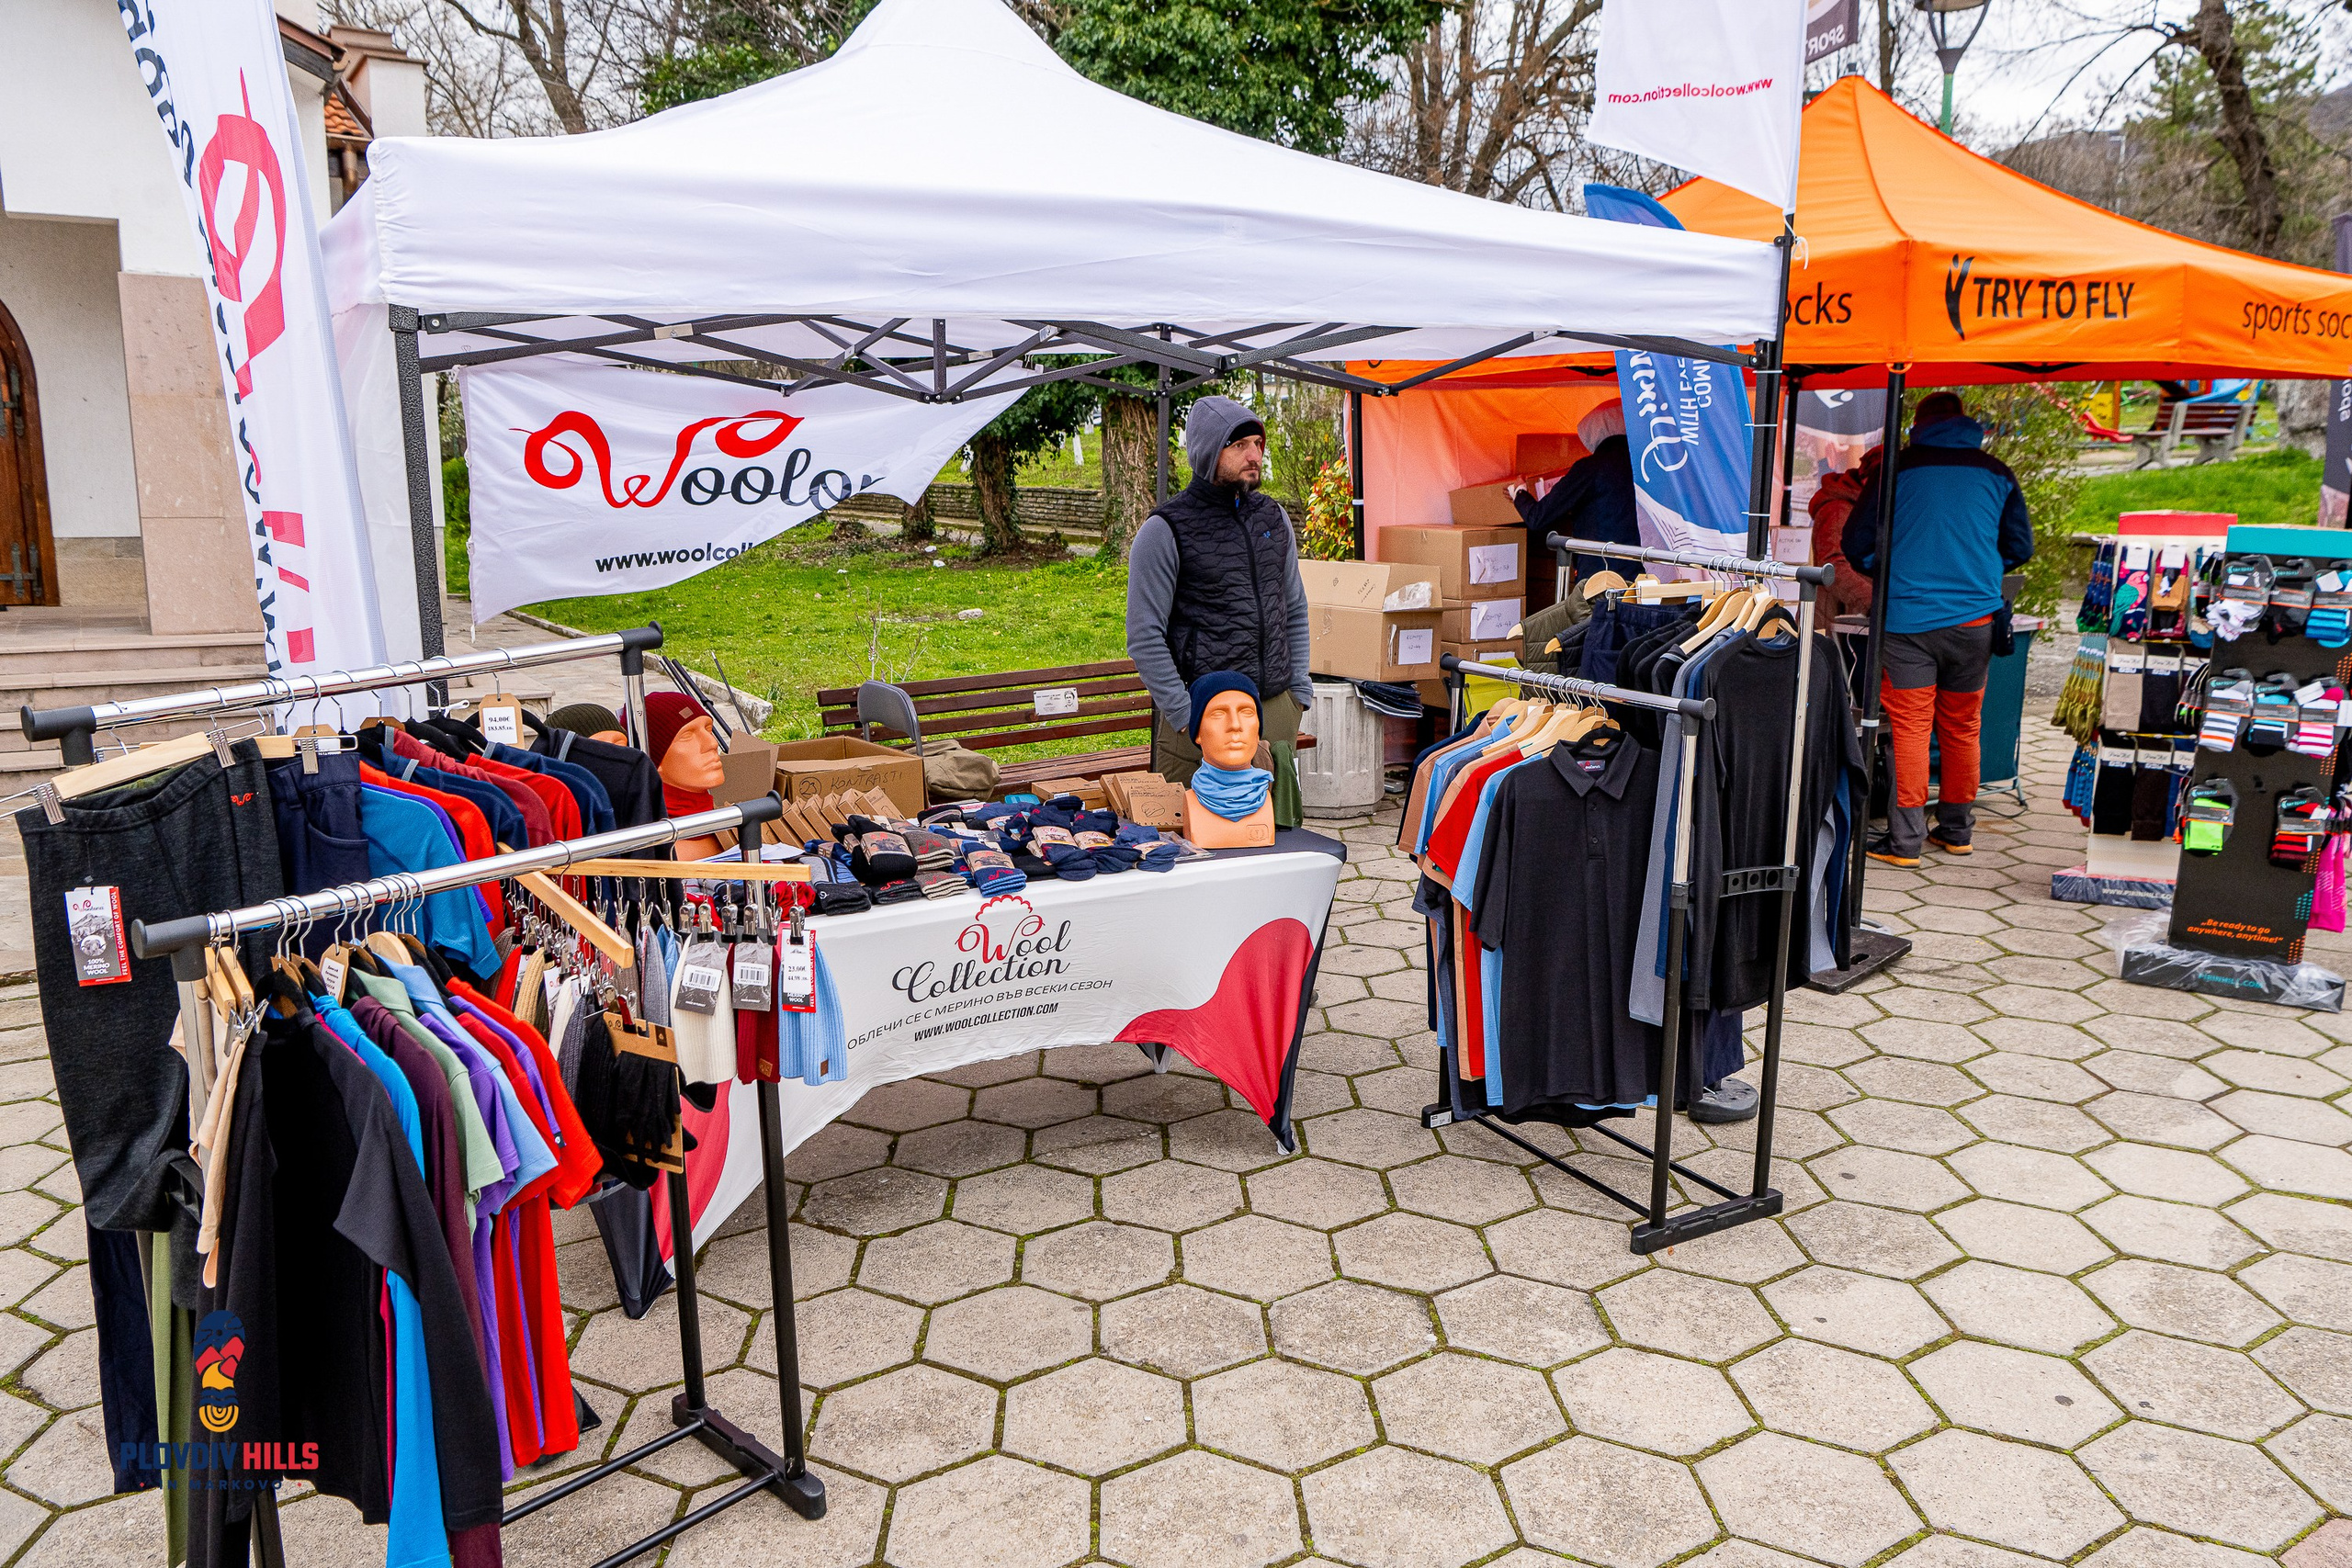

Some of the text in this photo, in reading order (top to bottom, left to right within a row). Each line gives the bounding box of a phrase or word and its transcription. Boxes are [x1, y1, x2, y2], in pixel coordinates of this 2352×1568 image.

[1973, 277, 2135, 319] TRY TO FLY
[2242, 301, 2312, 339] sports
[799, 771, 902, 795] 23 KONTRASTI
[955, 915, 1071, 964] Wool
[2187, 926, 2235, 938] anywhere,
[2219, 922, 2245, 931] ready
[892, 954, 1071, 1003] Collection
[847, 979, 1114, 1050] ОБЛЕЧИ СЕ С МЕРИНО ВЪВ ВСЕКИ СЕЗОН
[913, 1002, 1059, 1043] WWW.WOOLCOLLECTION.COM
